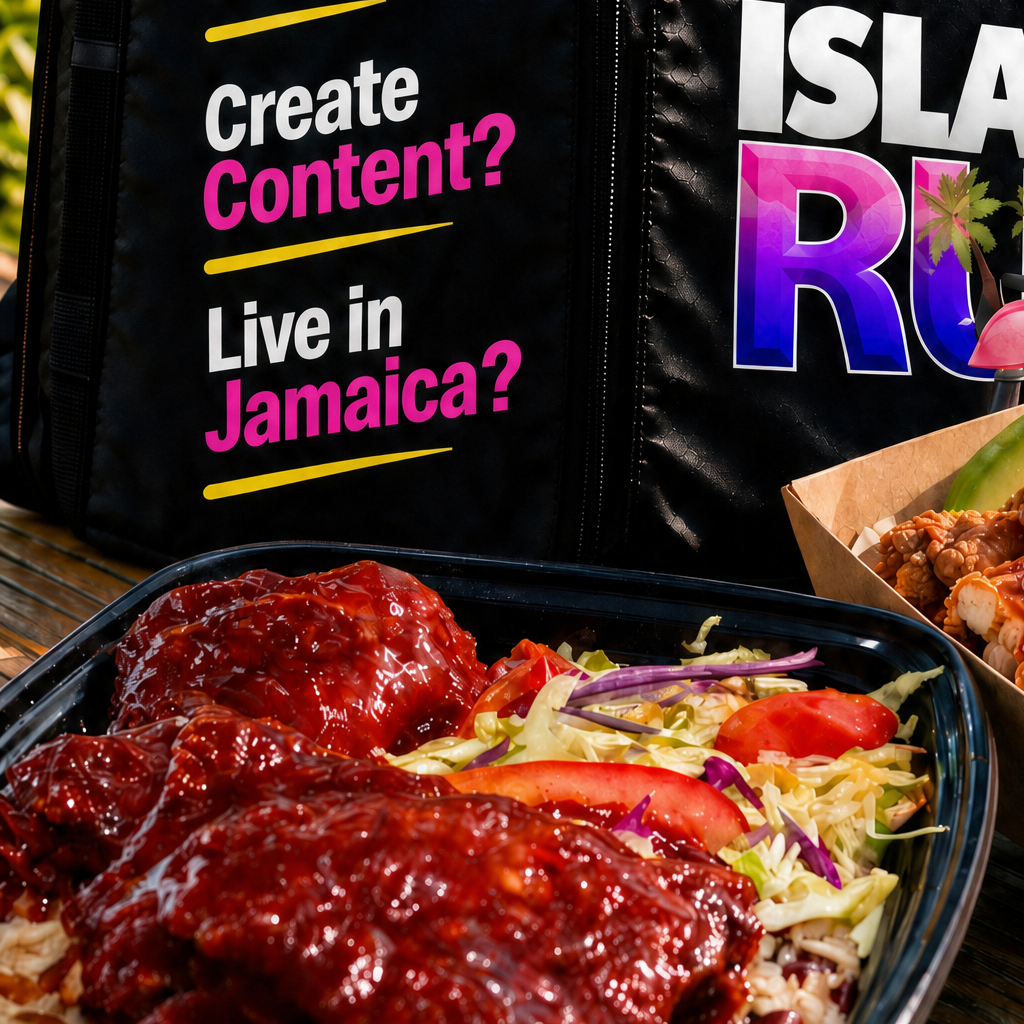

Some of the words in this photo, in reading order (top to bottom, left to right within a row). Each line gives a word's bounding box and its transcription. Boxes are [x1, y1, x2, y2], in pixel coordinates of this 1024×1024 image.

[205, 59, 419, 152] Create
[203, 112, 516, 231] Content?
[208, 300, 331, 373] Live
[348, 284, 403, 353] in
[205, 339, 522, 453] Jamaica?
